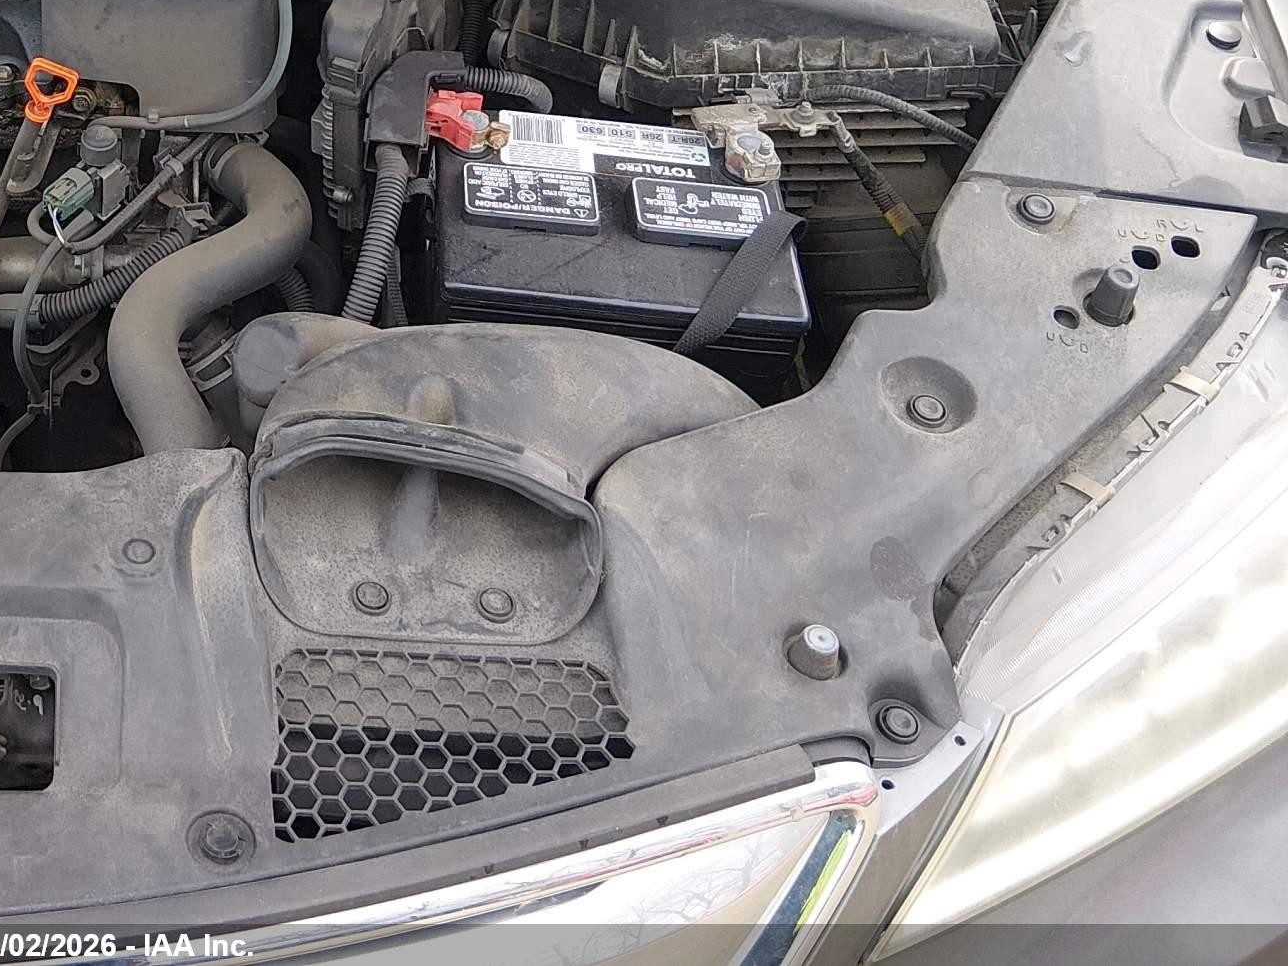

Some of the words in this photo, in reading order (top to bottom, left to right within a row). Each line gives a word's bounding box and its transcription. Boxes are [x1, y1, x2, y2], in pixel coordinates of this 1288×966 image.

[611, 128, 632, 136] 510
[615, 163, 696, 178] TOTALPRO
[711, 191, 738, 199] WATER
[475, 199, 571, 215] DANGER/POISON
